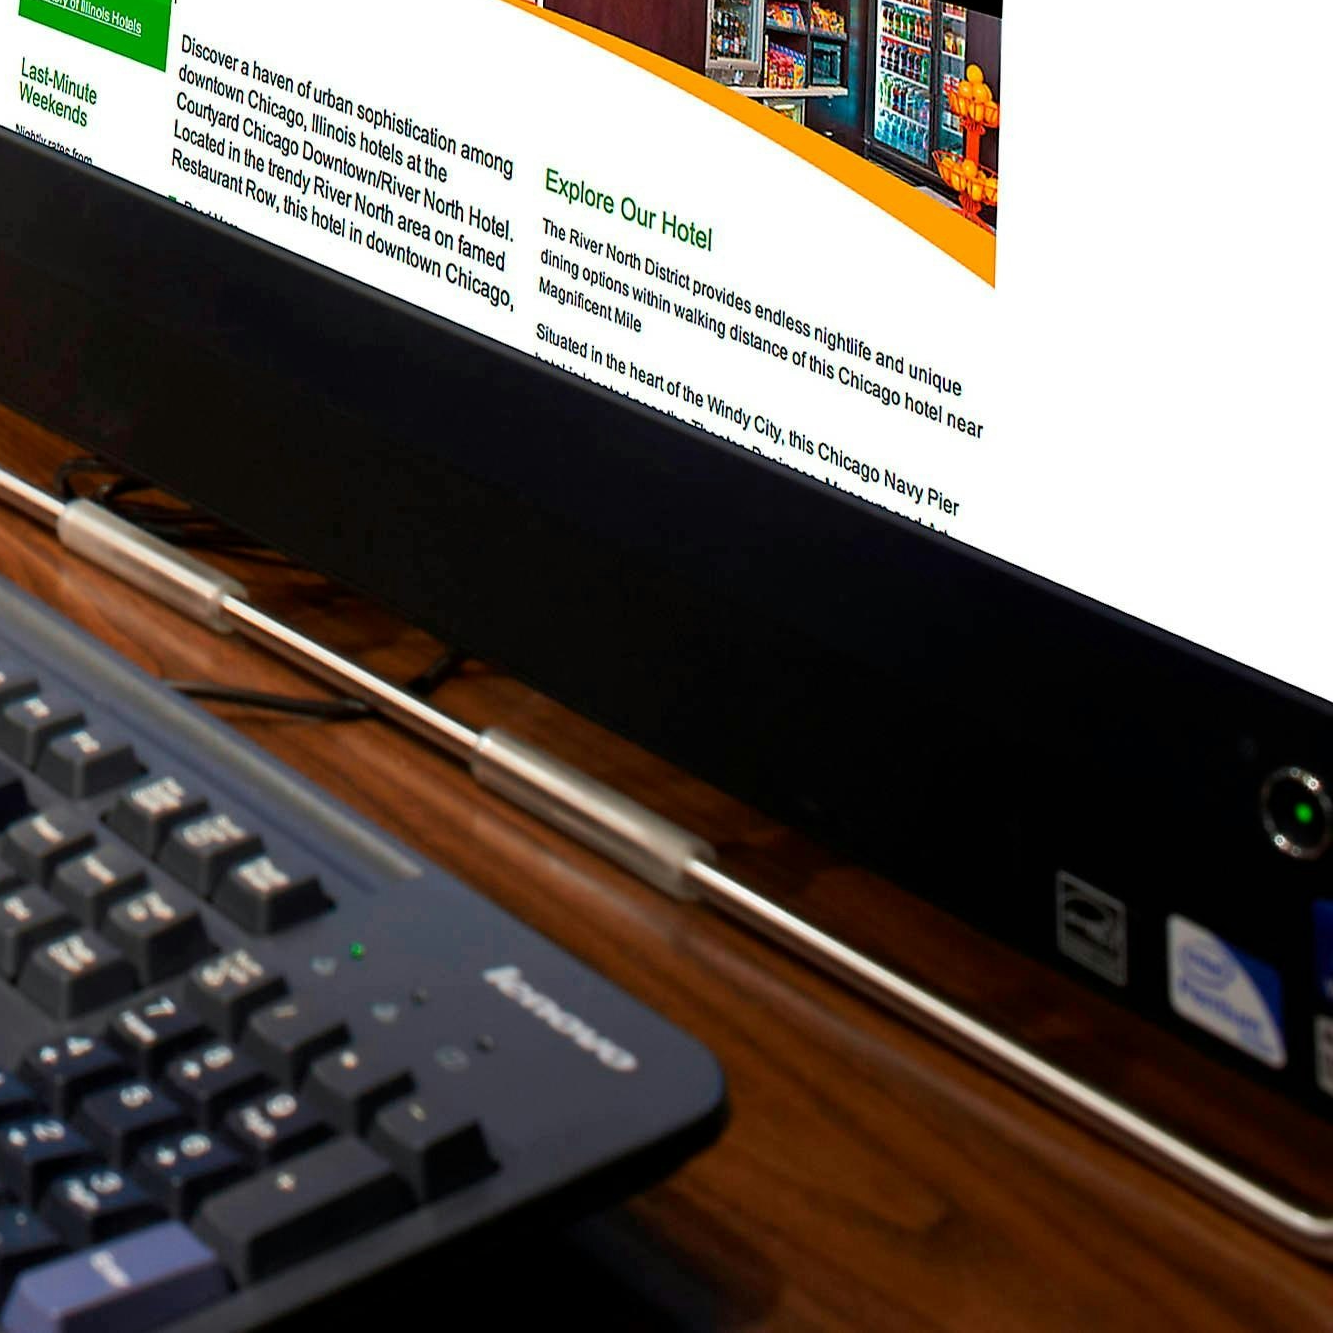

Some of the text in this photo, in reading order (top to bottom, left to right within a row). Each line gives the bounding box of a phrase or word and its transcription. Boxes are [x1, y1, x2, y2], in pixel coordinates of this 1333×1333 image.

[110, 8, 144, 35] Hotels
[19, 81, 88, 128] Weekends
[21, 56, 97, 106] Last-Minute
[178, 63, 448, 183] downtown Chicago, Illinois hotels at the
[181, 33, 513, 181] Discover a haven of urban sophistication among
[174, 118, 506, 272] Located in the trendy River North area on famed
[176, 91, 514, 243] Courtyard Chicago Downtown/River North Hotel.
[545, 167, 713, 252] Explore Our Hotel
[171, 147, 514, 313] Restaurant Row, this hotel in downtown Chicago,
[539, 276, 642, 333] Magnificent Mile
